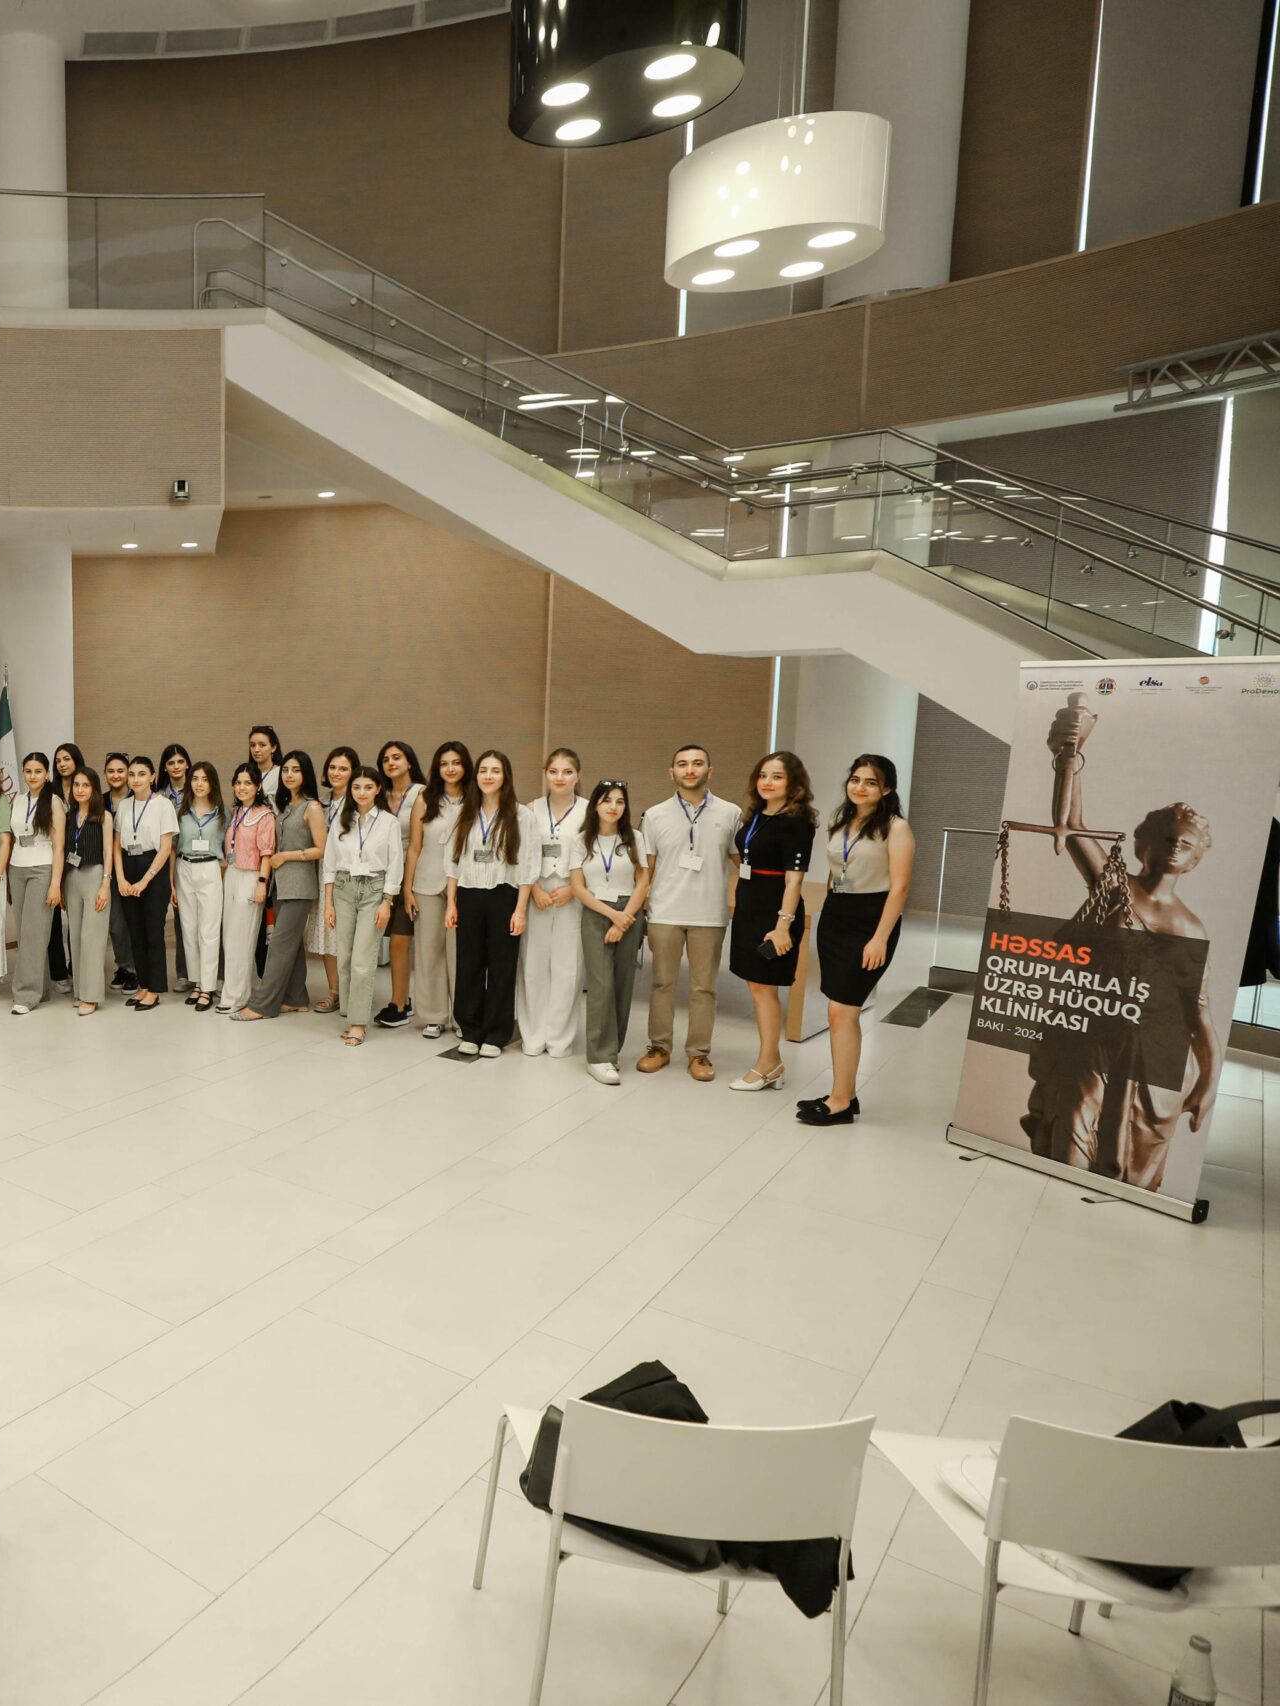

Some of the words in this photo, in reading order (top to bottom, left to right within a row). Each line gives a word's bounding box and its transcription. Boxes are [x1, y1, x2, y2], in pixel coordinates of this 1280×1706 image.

[1139, 677, 1163, 687] elsa
[990, 932, 1092, 966] HƏSSAS
[986, 955, 1122, 995] QRUPLARLA
[1128, 976, 1151, 1003] İŞ
[980, 996, 1089, 1033] KLİNİKASI
[983, 972, 1043, 1000] ÜZRƏ
[1048, 988, 1142, 1024] HÜQUQ
[977, 1018, 1004, 1032] BAKI
[1014, 1026, 1044, 1041] 2024
